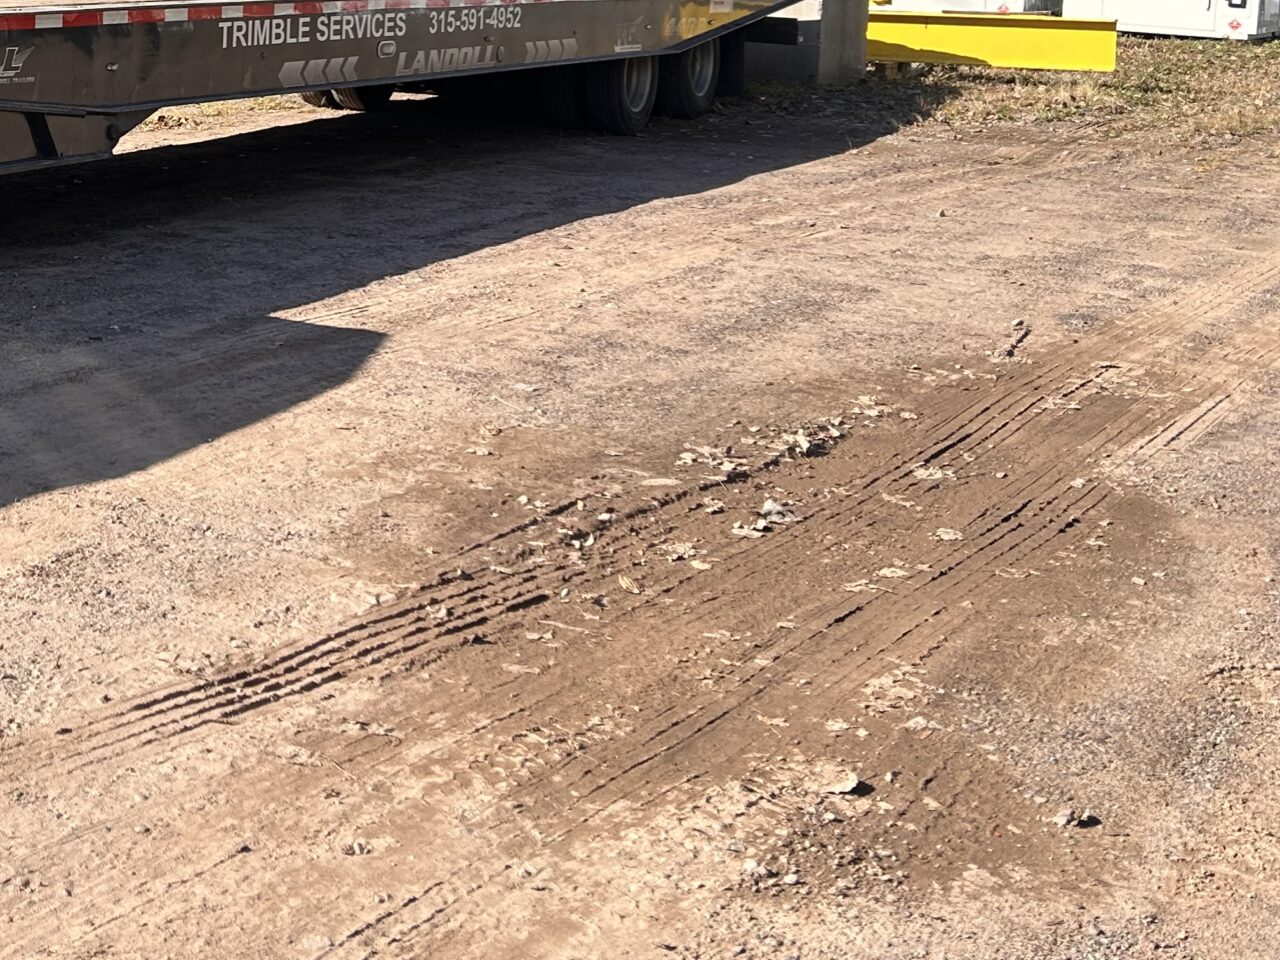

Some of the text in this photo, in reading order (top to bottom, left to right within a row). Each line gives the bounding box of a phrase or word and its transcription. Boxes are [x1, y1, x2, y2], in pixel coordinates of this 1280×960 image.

[218, 6, 522, 49] TRIMBLE SERVICES 315-591-4952
[394, 44, 498, 77] LANDOLL
